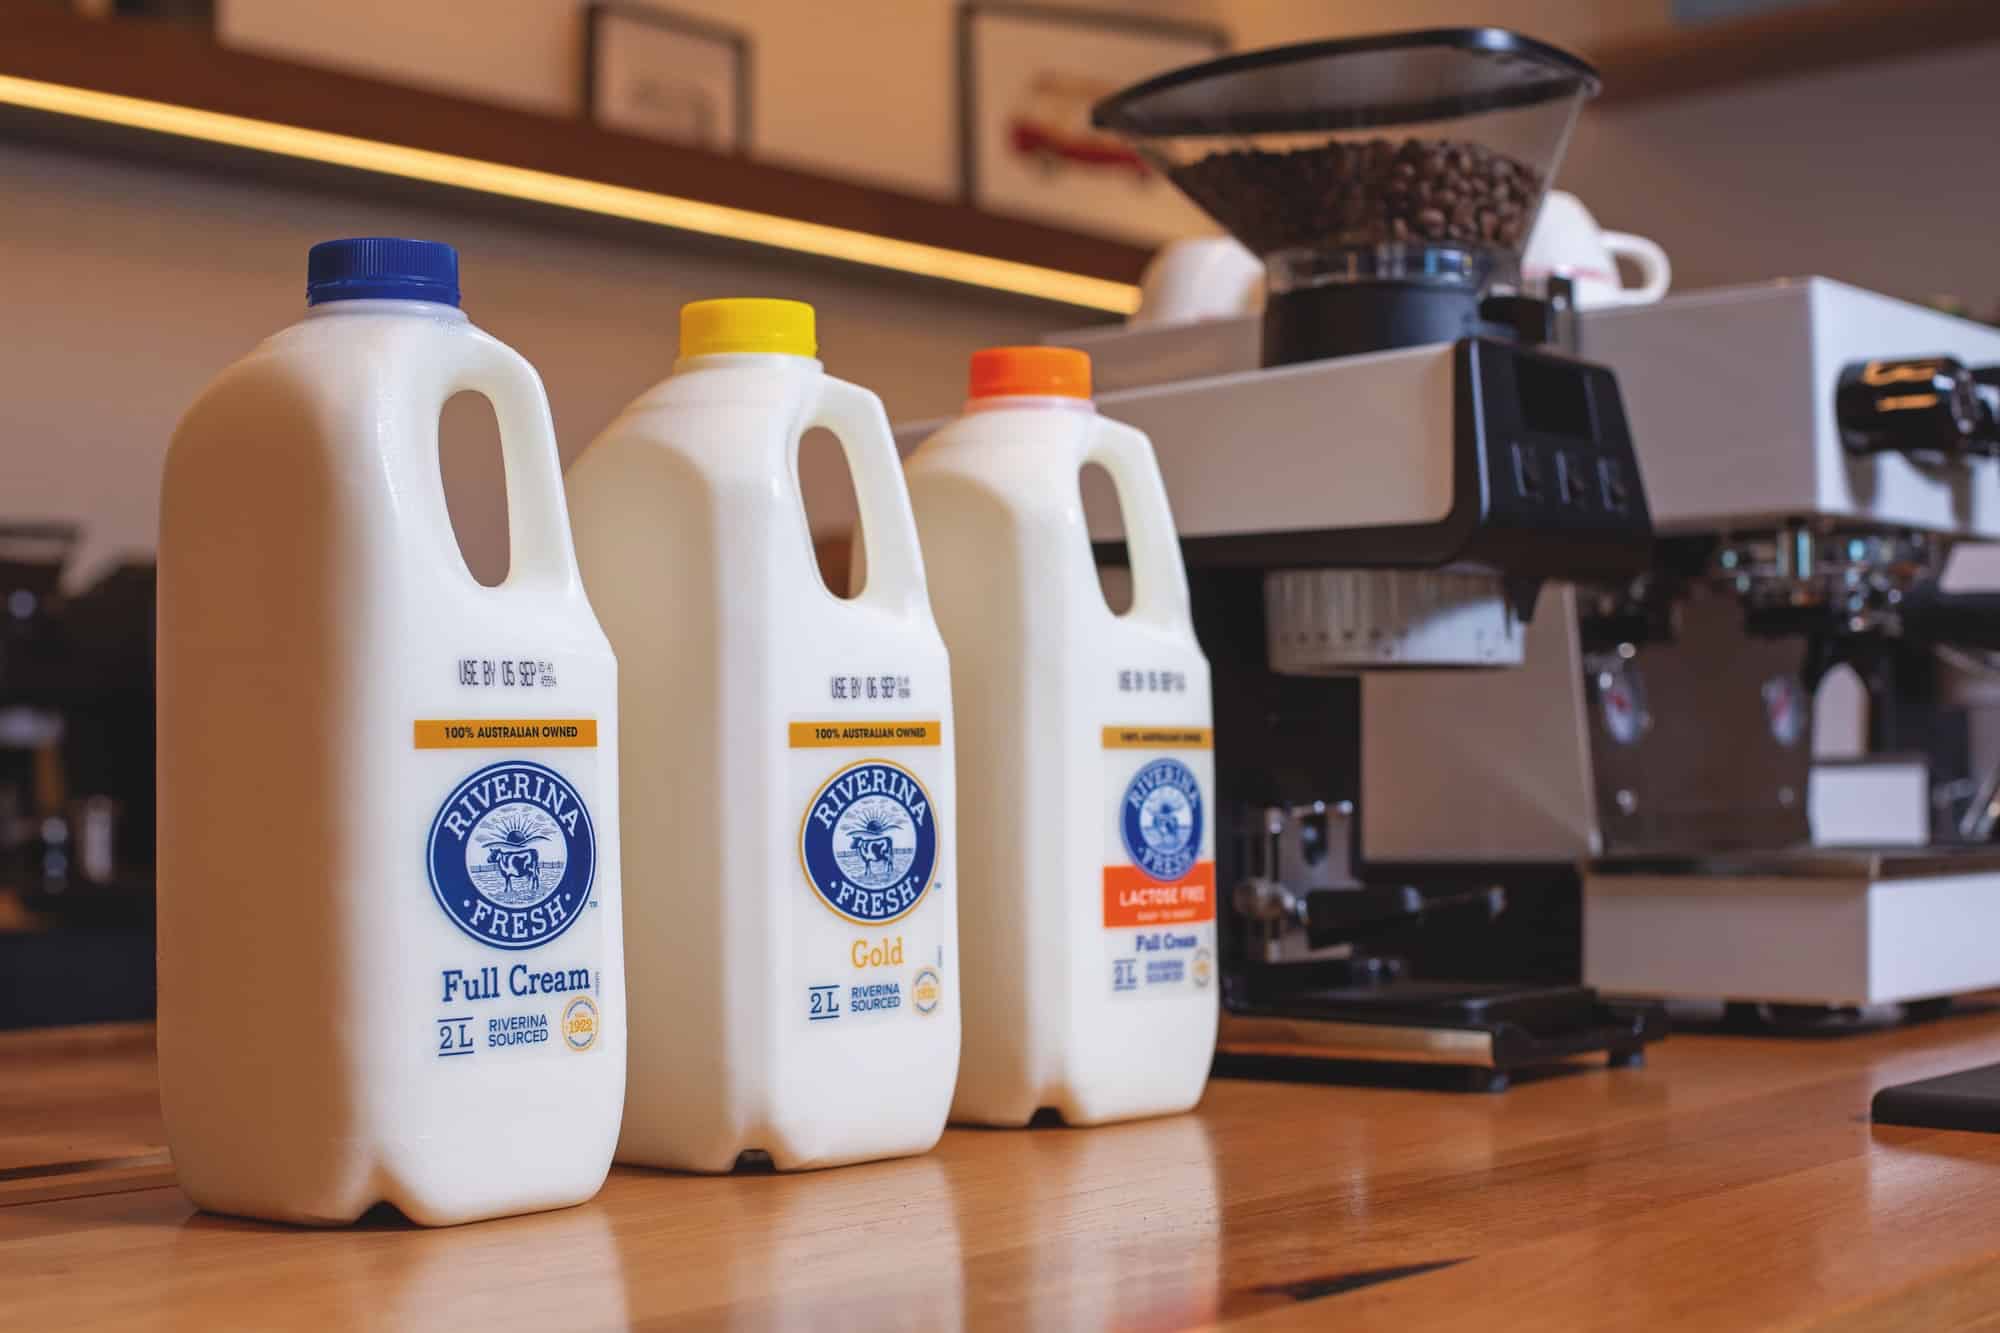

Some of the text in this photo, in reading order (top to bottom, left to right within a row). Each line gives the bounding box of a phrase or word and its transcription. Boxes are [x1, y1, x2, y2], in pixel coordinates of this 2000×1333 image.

[458, 660, 480, 686] USE
[482, 660, 496, 686] BY
[519, 661, 537, 687] SEP
[444, 726, 578, 739] 100% AUSTRALIAN OWNED
[815, 727, 926, 740] 100% AUSTRALIAN OWNED
[444, 773, 580, 841] RIVERINA
[814, 769, 927, 829] RIVERINA
[836, 877, 917, 917] FRESH
[469, 894, 567, 939] FRESH
[851, 936, 904, 969] Gold
[442, 966, 500, 1002] Full
[509, 964, 591, 997] Cream
[851, 983, 900, 1000] RIVERINA
[851, 996, 900, 1012] SOURCED
[488, 1014, 548, 1032] RIVERINA
[488, 1028, 549, 1048] SOURCED
